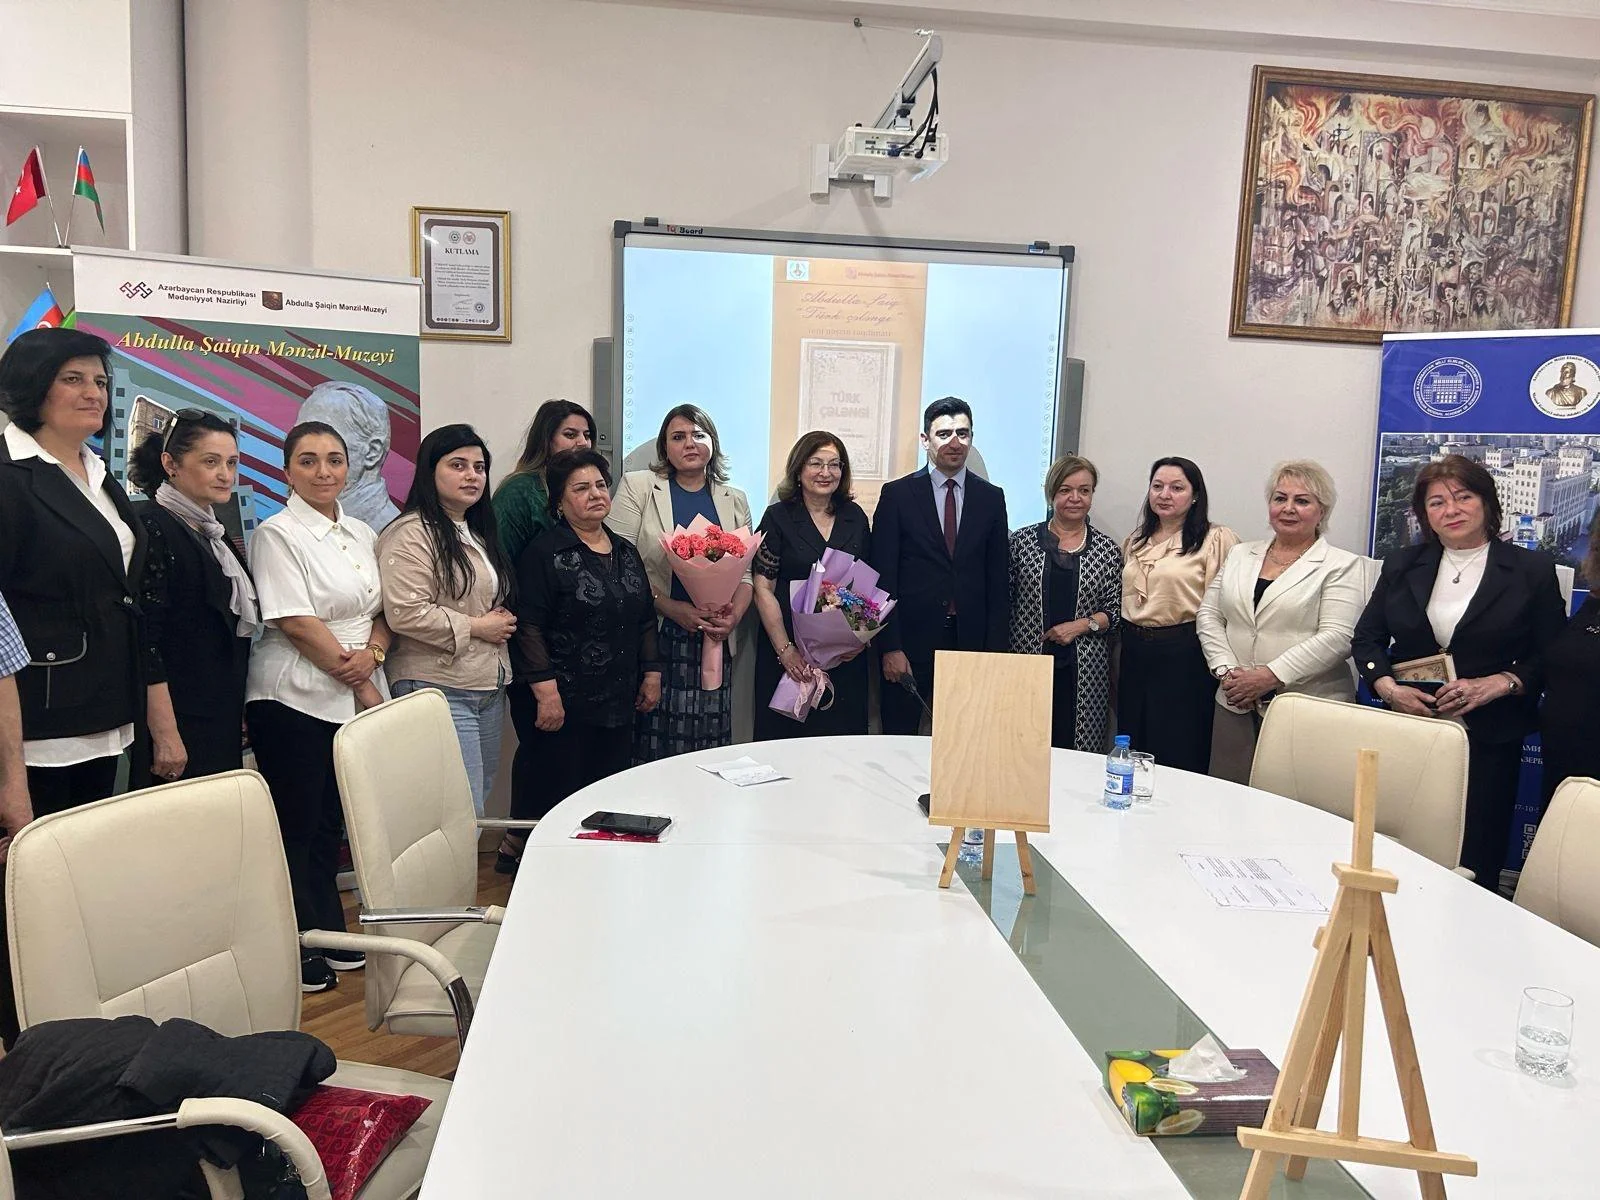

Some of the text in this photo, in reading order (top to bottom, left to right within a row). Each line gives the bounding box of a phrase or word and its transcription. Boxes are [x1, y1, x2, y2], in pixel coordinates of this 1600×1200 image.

[679, 226, 704, 235] Board
[445, 247, 480, 256] KUTLAMA
[158, 284, 256, 298] Azərbaycan Respublikası
[168, 293, 247, 306] Mədəniyyət Nazirliyi
[285, 299, 388, 314] Abdulla Şaiqin Mənzil-Muzeyi
[115, 331, 396, 366] Abdulla Şaiqin Mənzil-Muzeyi
[831, 390, 861, 404] TÜRK
